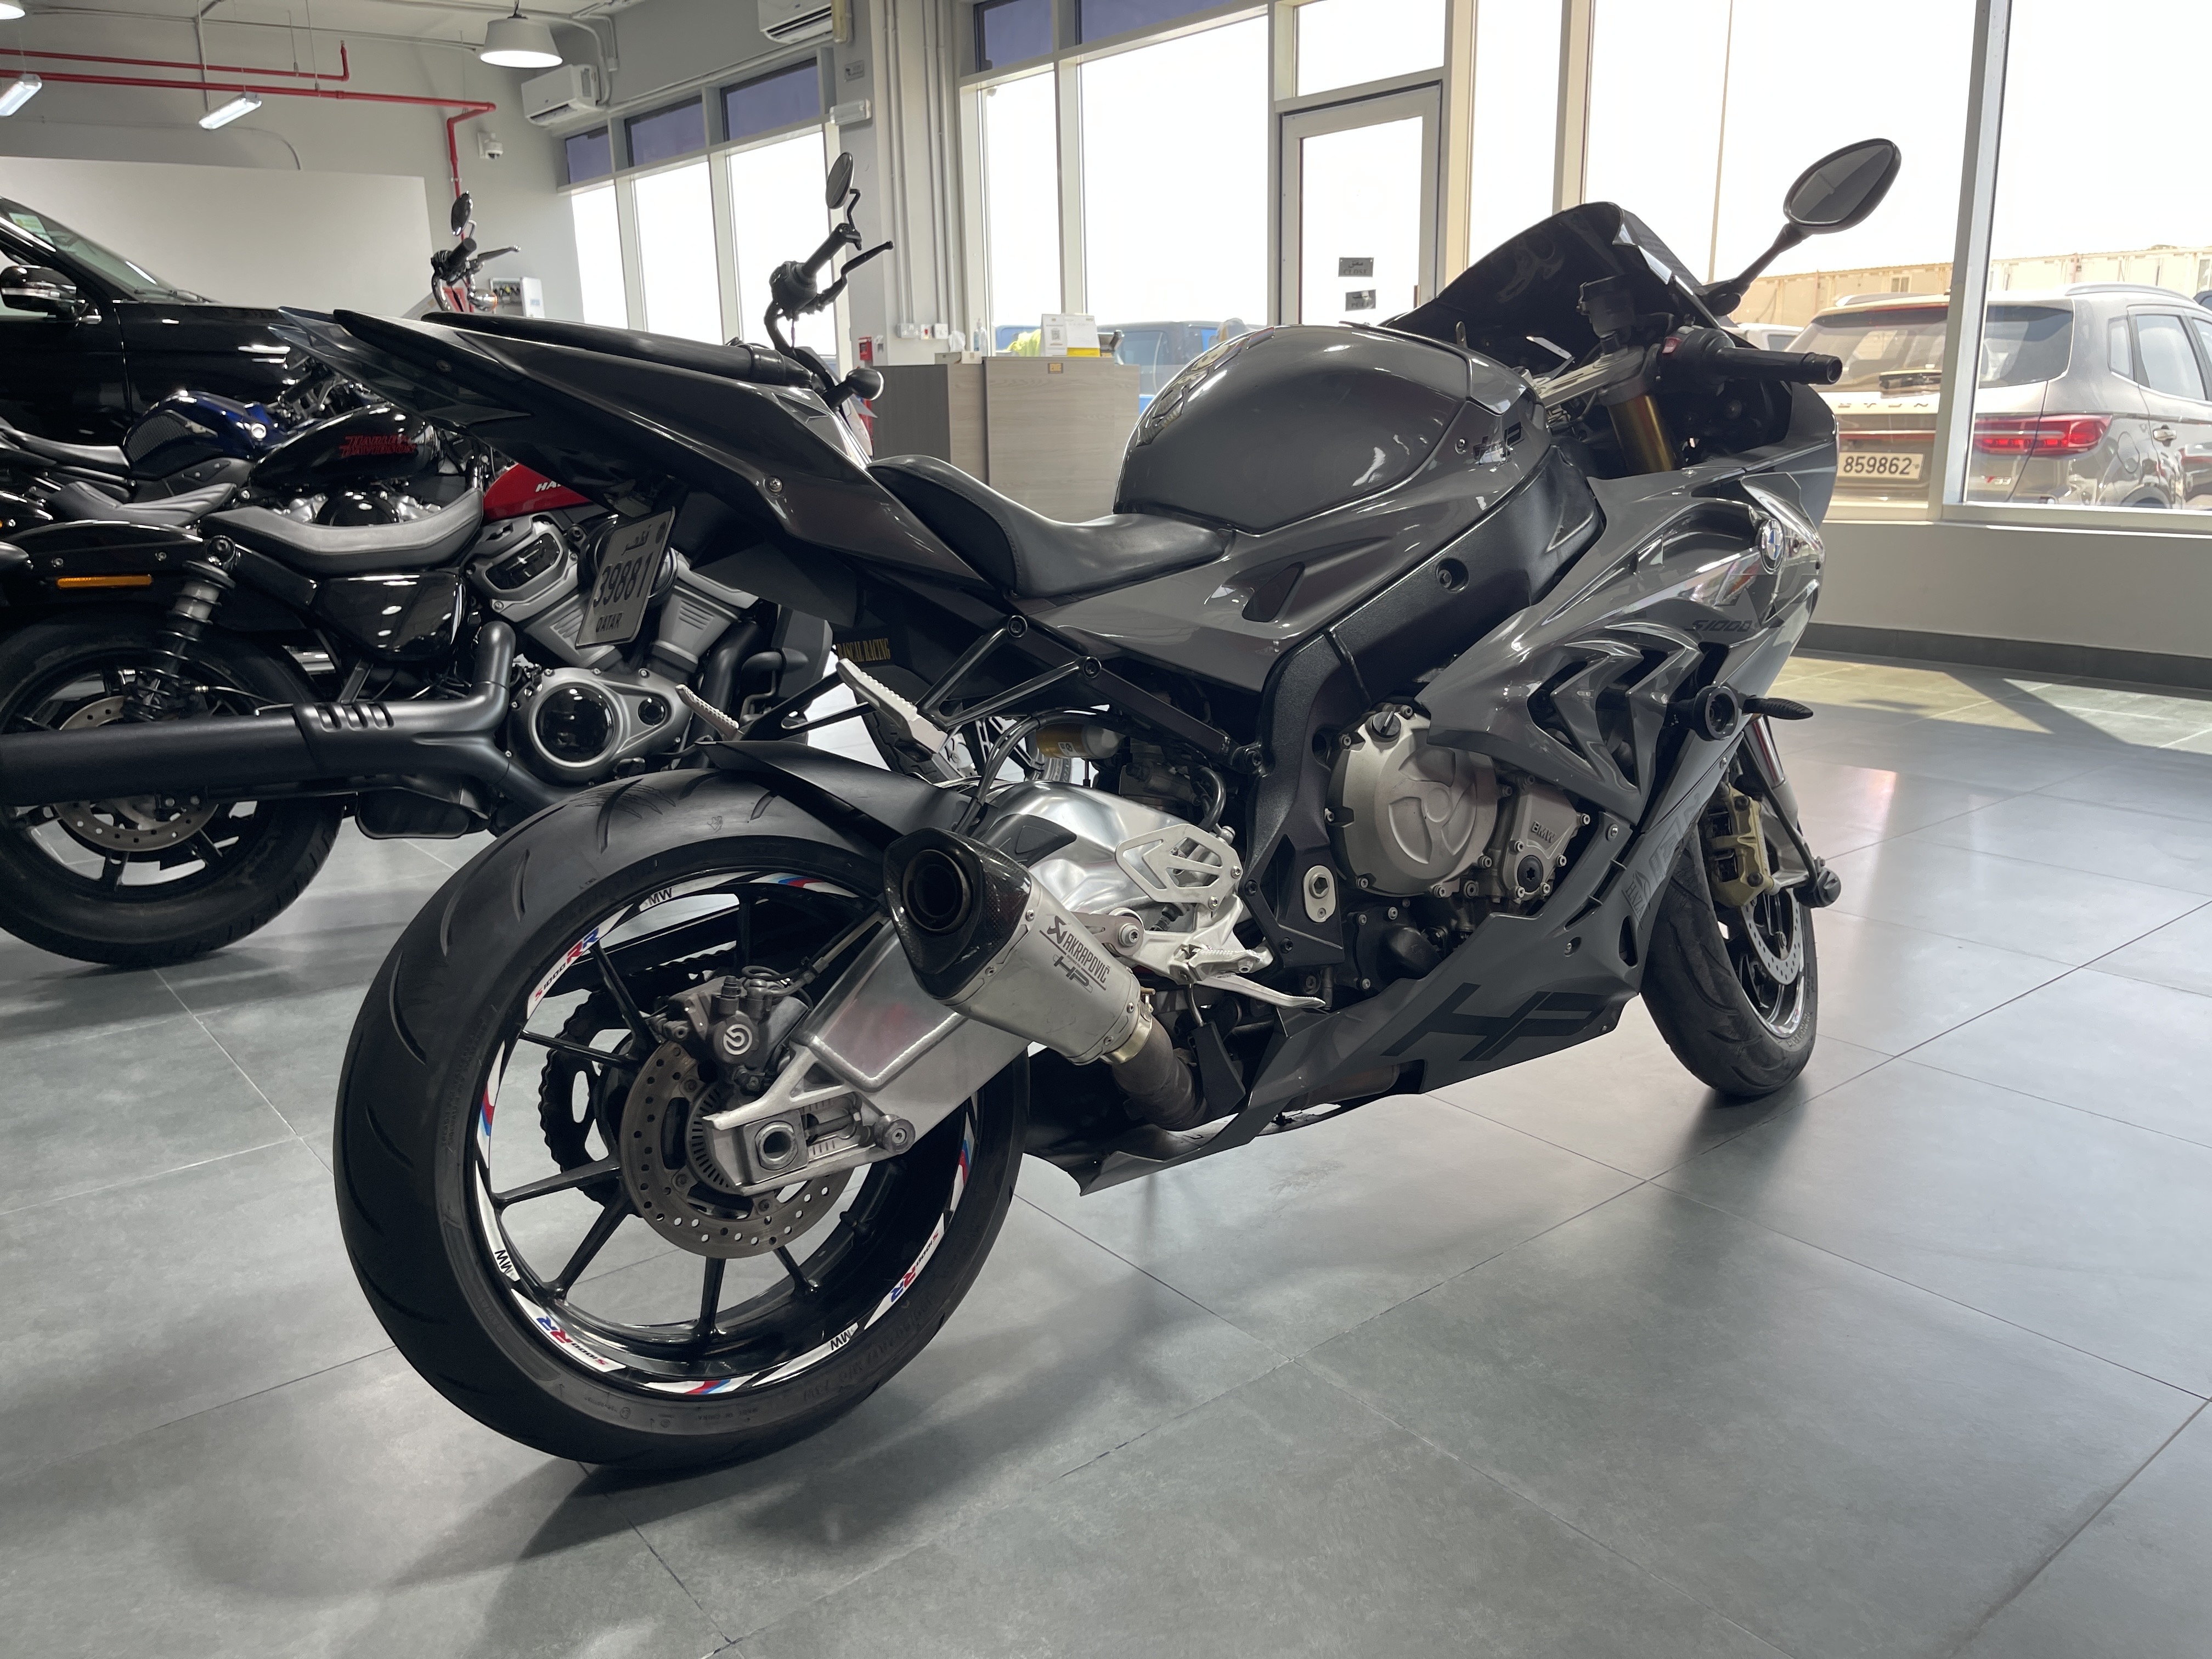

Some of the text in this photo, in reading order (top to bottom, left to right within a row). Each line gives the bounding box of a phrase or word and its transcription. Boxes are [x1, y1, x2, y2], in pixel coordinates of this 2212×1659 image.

[1843, 455, 1912, 475] 859862
[593, 551, 653, 608] 39881
[596, 612, 624, 633] QATAR
[1531, 821, 1556, 843] BMW
[1053, 955, 1090, 987] HP
[1063, 933, 1111, 984] AKRAPOVIČ
